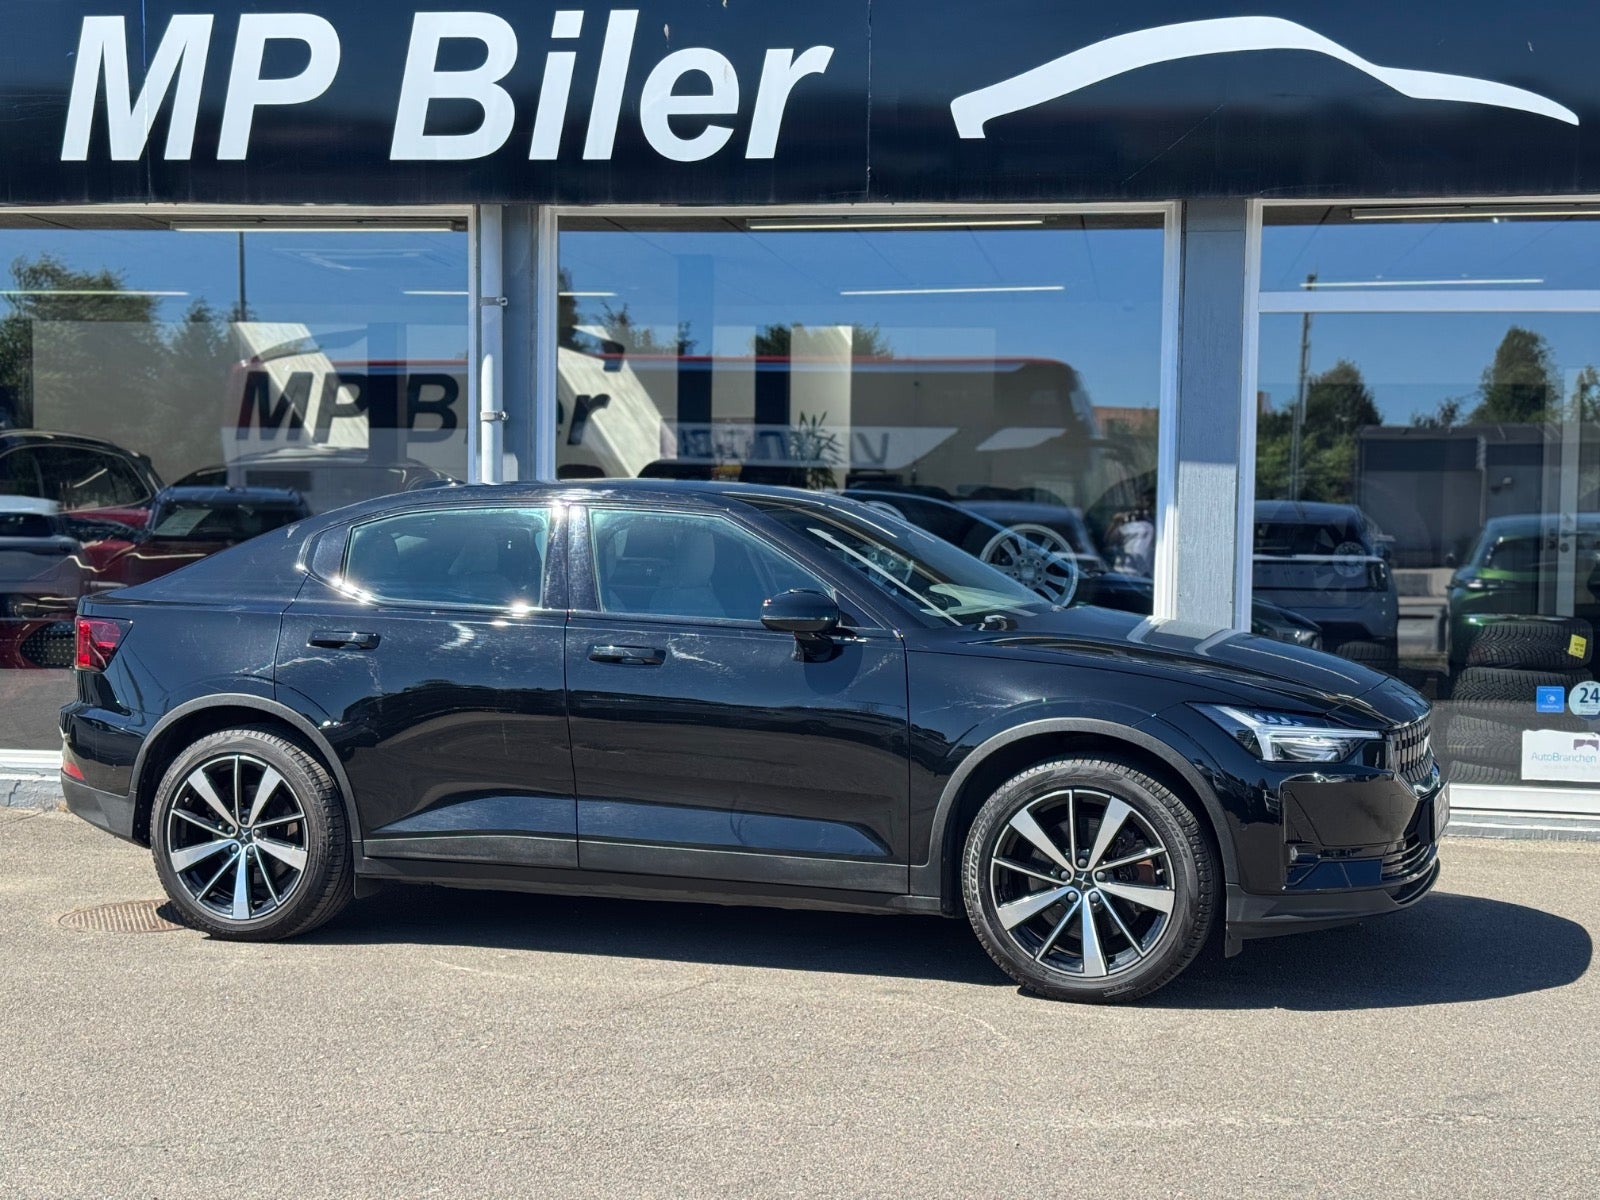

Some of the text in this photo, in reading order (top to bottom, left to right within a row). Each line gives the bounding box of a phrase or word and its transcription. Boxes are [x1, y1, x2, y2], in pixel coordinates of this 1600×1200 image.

[61, 10, 834, 161] MP Biler
[236, 371, 368, 443] MP
[1531, 752, 1597, 763] AutoBranchen
